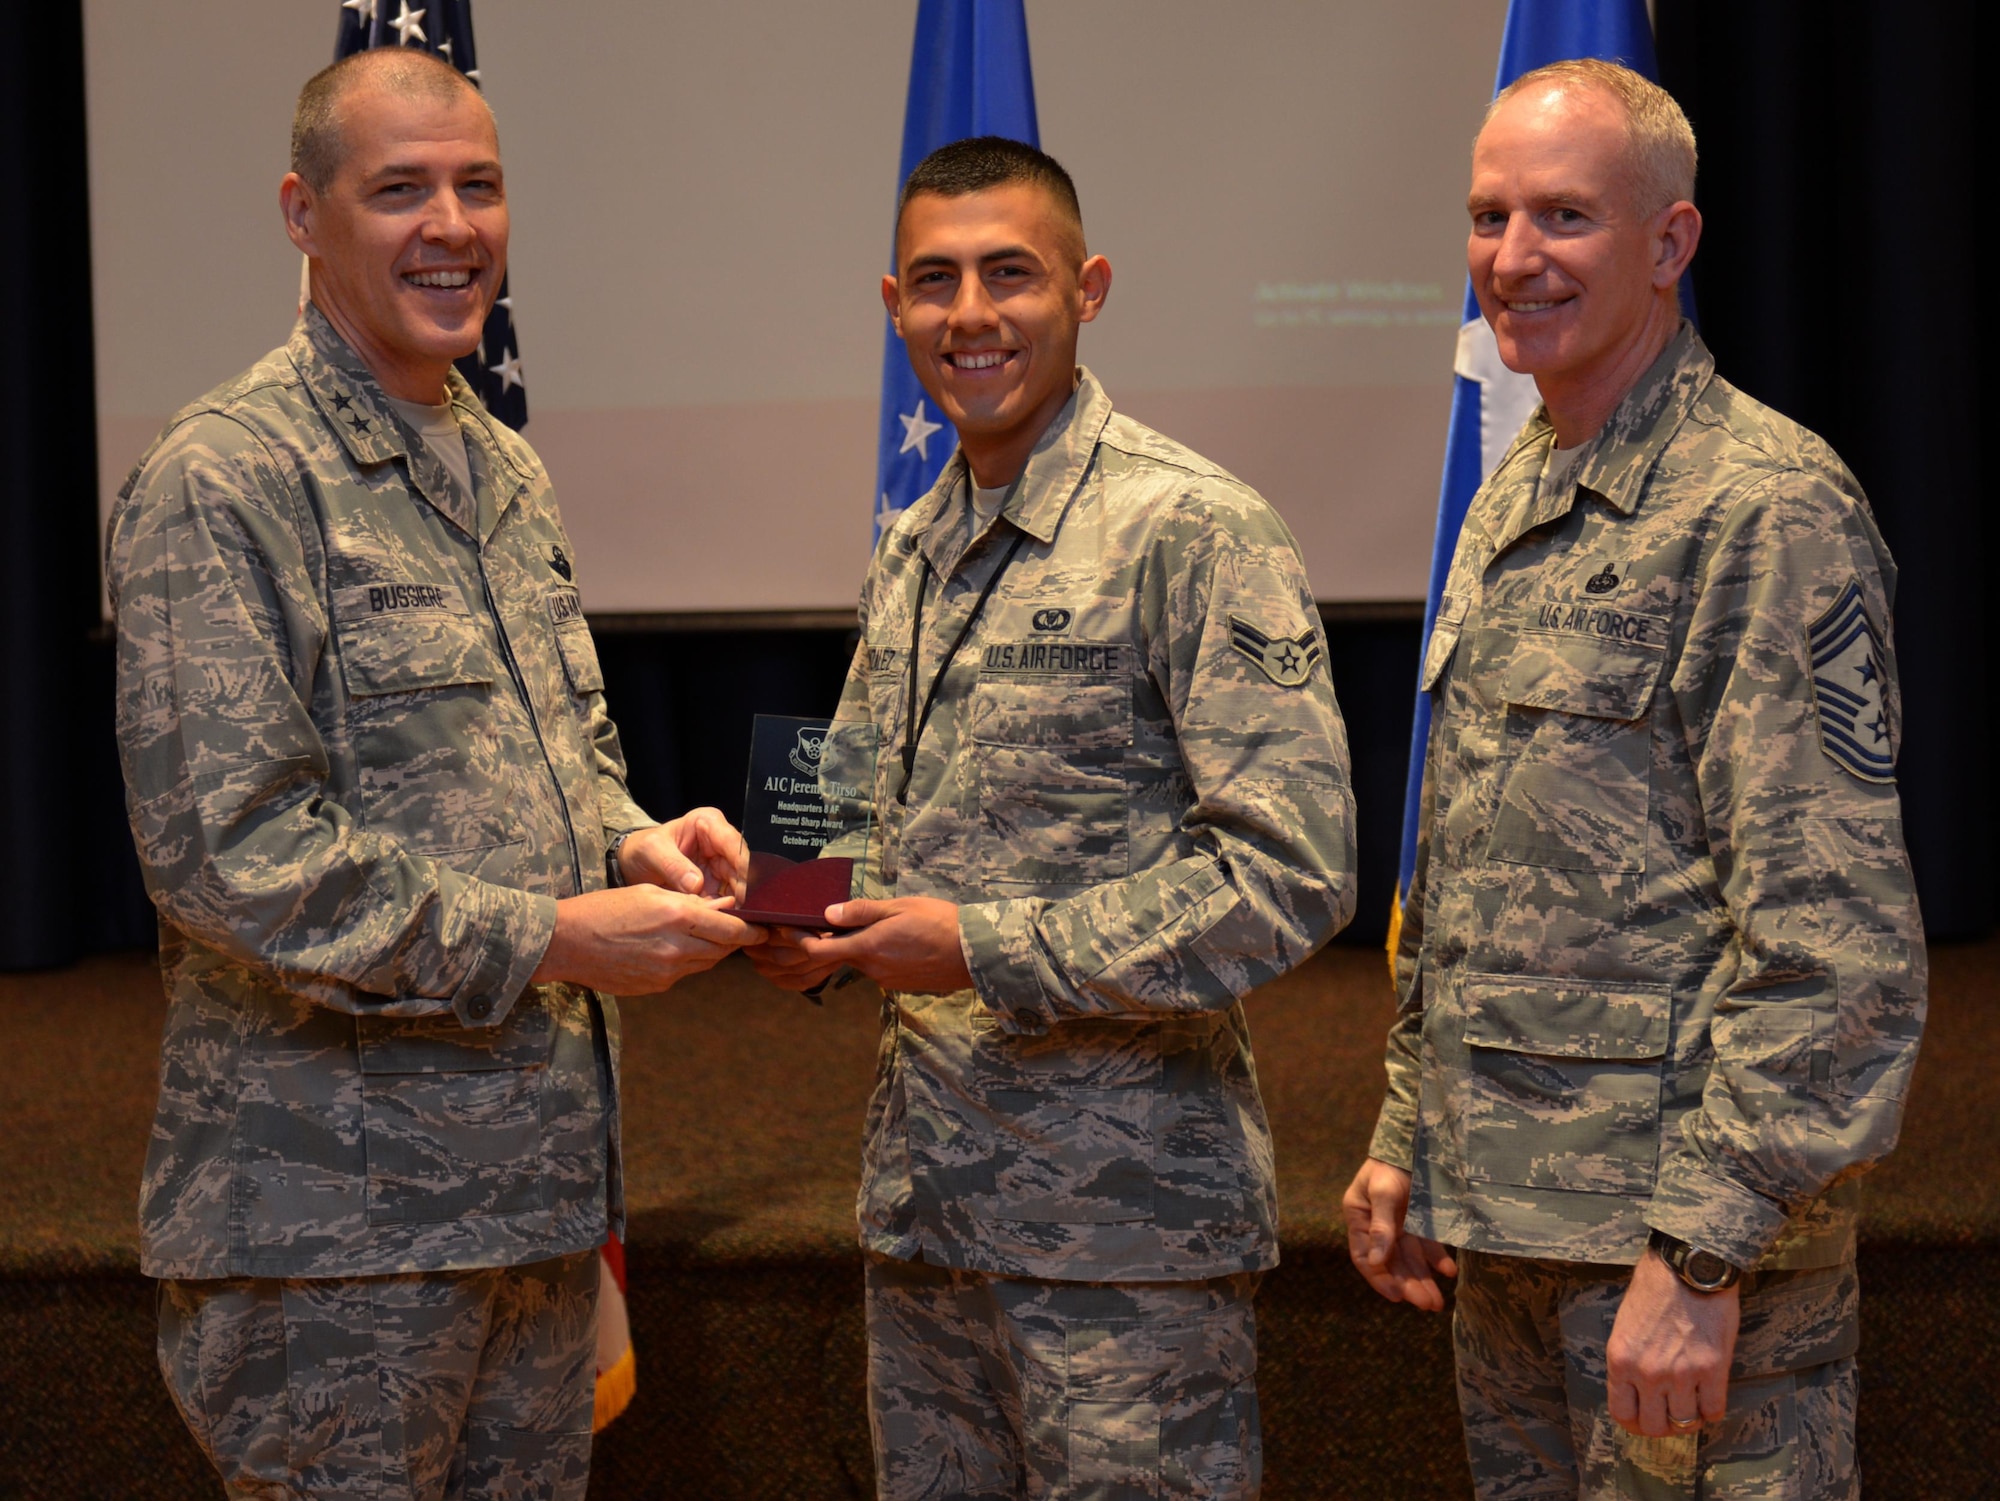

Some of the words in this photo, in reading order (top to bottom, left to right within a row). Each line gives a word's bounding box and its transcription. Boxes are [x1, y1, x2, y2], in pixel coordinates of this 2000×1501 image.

[369, 586, 447, 612] BUSSIERE
[1538, 603, 1562, 629] U.S.
[1586, 609, 1651, 642] FORCE
[986, 645, 1015, 669] U.S.
[1018, 645, 1047, 670] AIR
[1048, 645, 1119, 671] FORCE
[829, 781, 857, 798] Tirso
[777, 800, 823, 814] Headquarters
[830, 804, 840, 815] AF
[770, 814, 800, 826] Diamond
[800, 816, 821, 830] Sharp
[821, 818, 844, 830] Award
[782, 835, 810, 847] October
